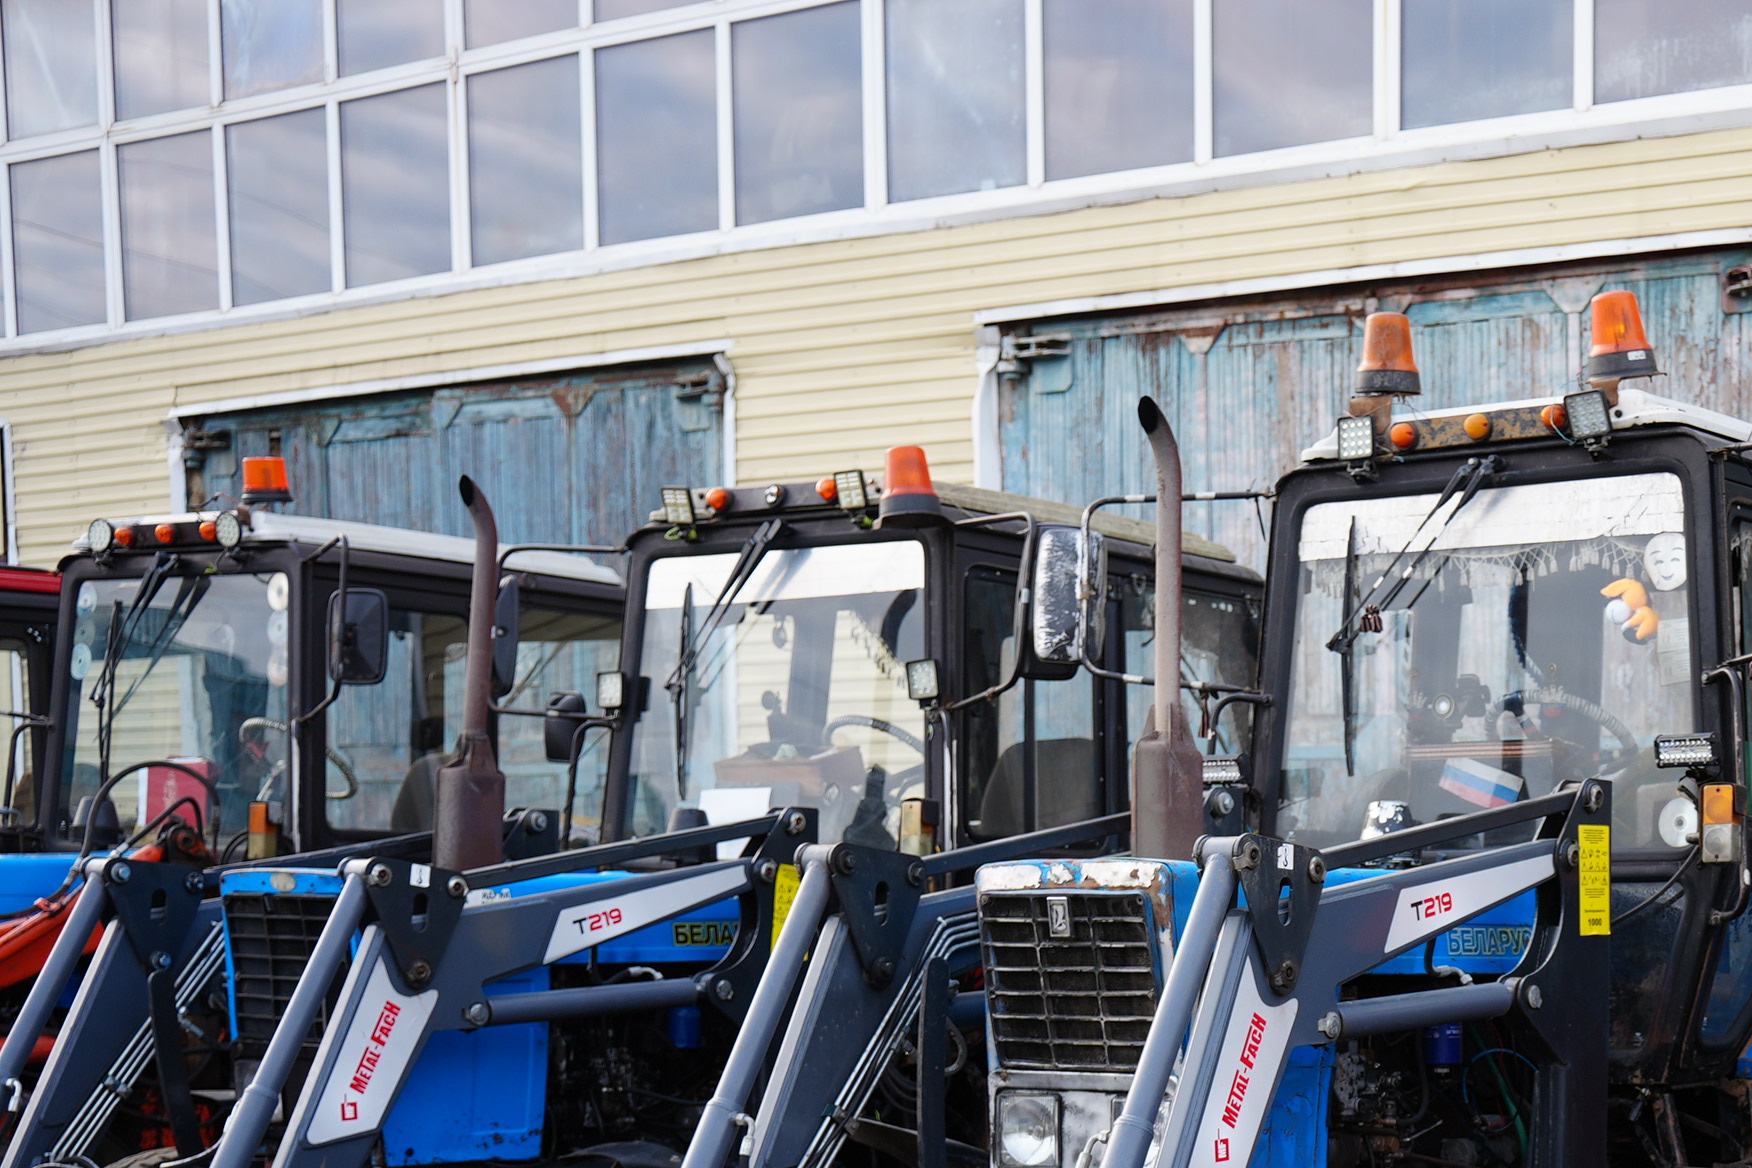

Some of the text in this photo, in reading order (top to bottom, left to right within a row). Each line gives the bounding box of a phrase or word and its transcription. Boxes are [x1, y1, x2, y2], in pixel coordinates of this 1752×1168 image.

[1410, 892, 1453, 921] T219
[572, 908, 623, 934] T219
[1588, 918, 1603, 926] 1000
[1221, 1012, 1267, 1129] METAL-FACH
